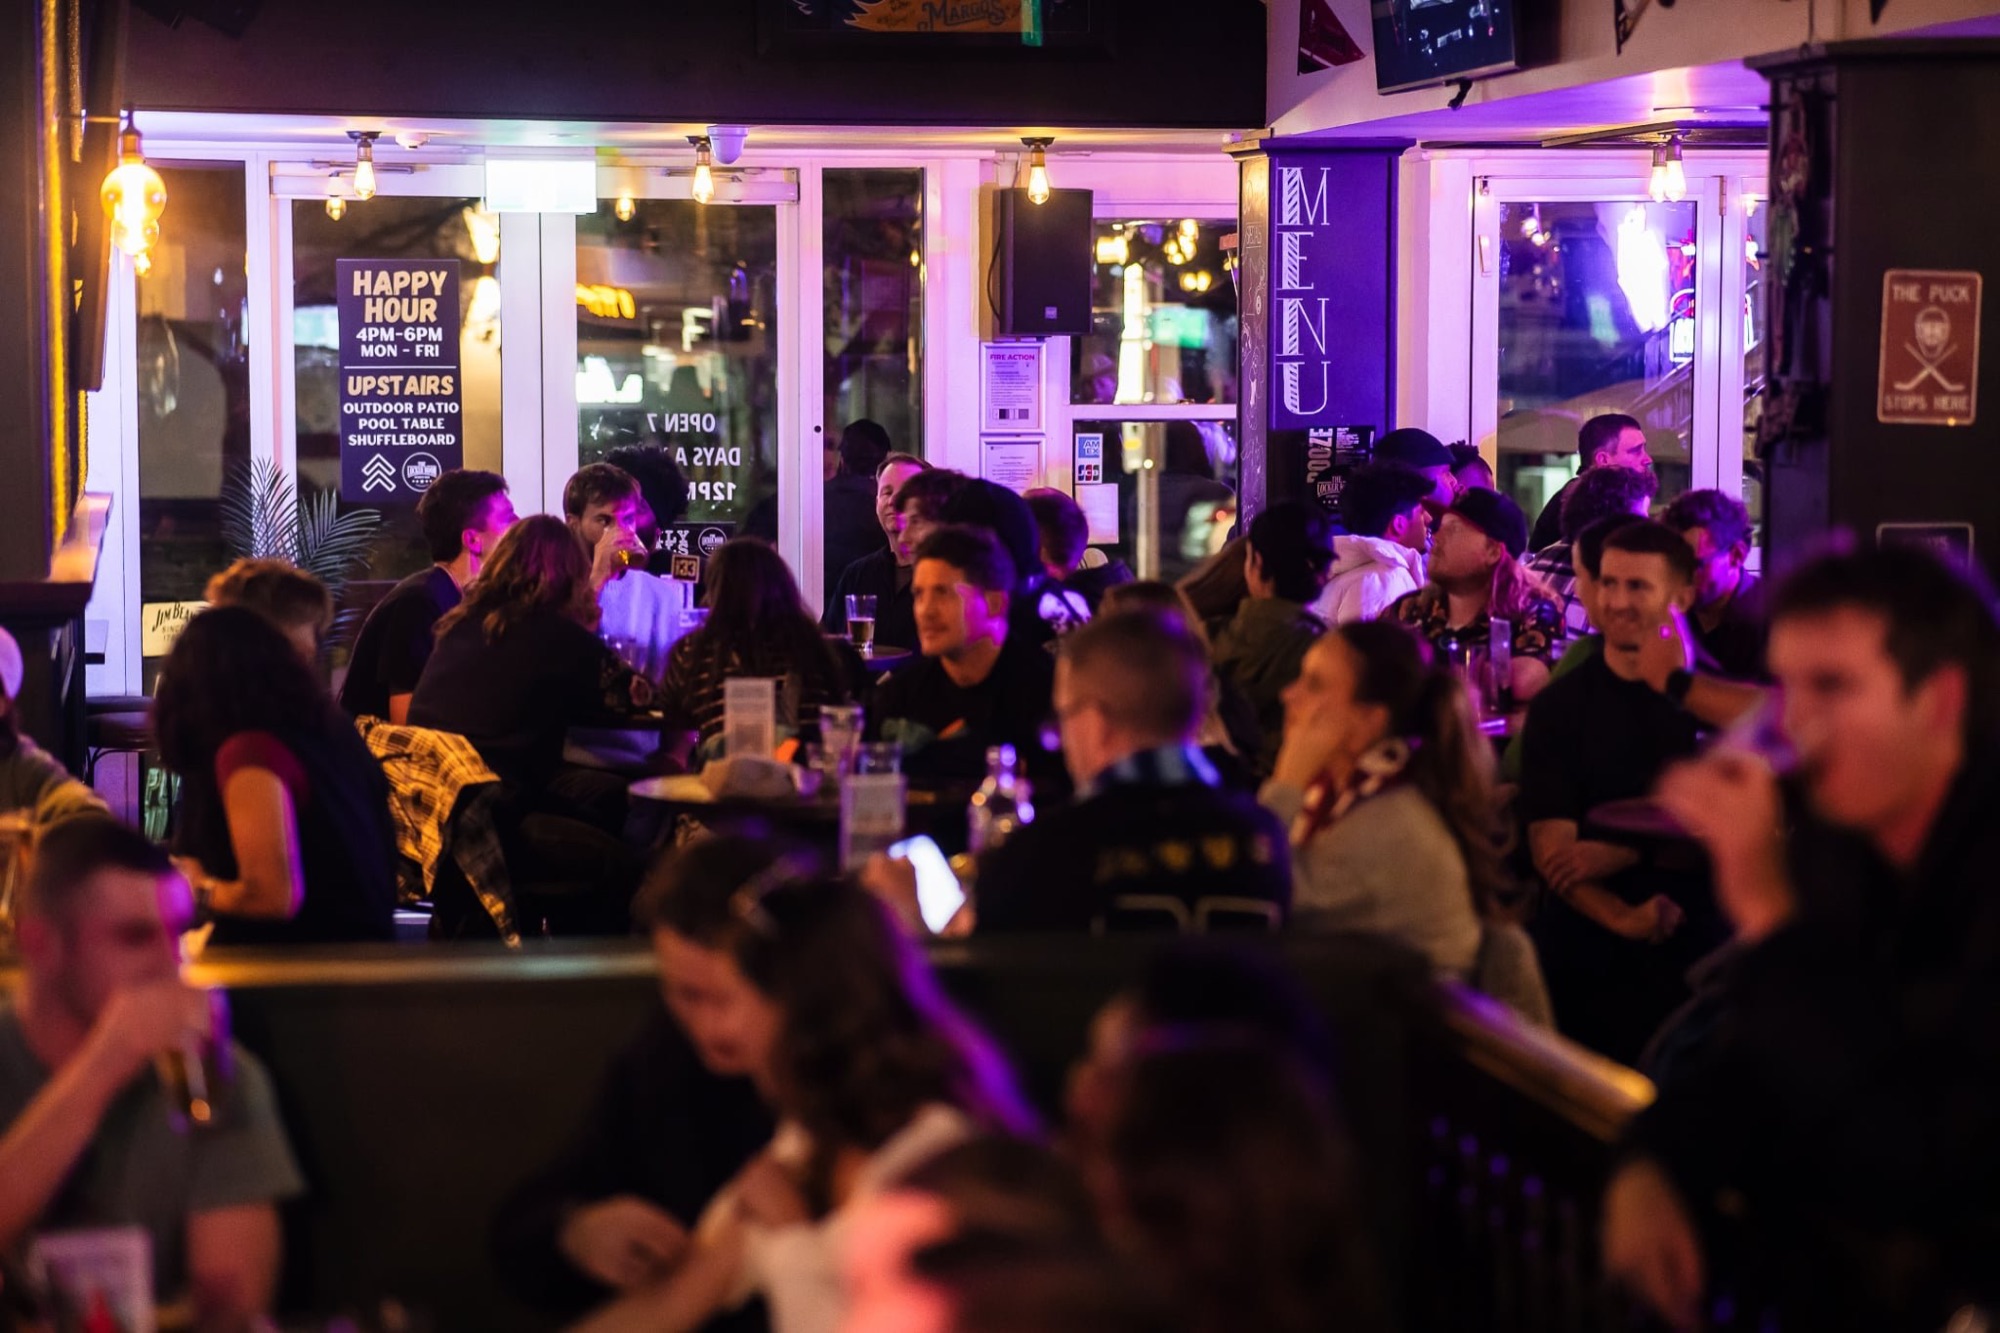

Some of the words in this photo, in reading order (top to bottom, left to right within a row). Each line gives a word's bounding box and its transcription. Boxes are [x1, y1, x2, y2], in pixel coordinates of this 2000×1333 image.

[353, 270, 448, 296] HAPPY
[1277, 166, 1331, 415] MENU
[1892, 283, 1921, 302] THE
[1929, 284, 1970, 303] PUCK
[364, 297, 438, 323] HOUR
[356, 327, 443, 341] 4PM-6PM
[361, 344, 398, 357] MON
[415, 344, 440, 357] FRI
[347, 375, 454, 396] UPSTAIRS
[343, 402, 414, 414] OUTDOOR
[417, 402, 460, 414] PATIO
[1884, 394, 1928, 411] STOPS
[1933, 394, 1969, 411] HERE
[358, 418, 398, 430] POOL
[401, 418, 445, 429] TABLE
[347, 434, 456, 446] SHUFFLEBOARD
[1083, 439, 1100, 449] AM
[1085, 447, 1100, 456] EX
[152, 608, 171, 632] JIM
